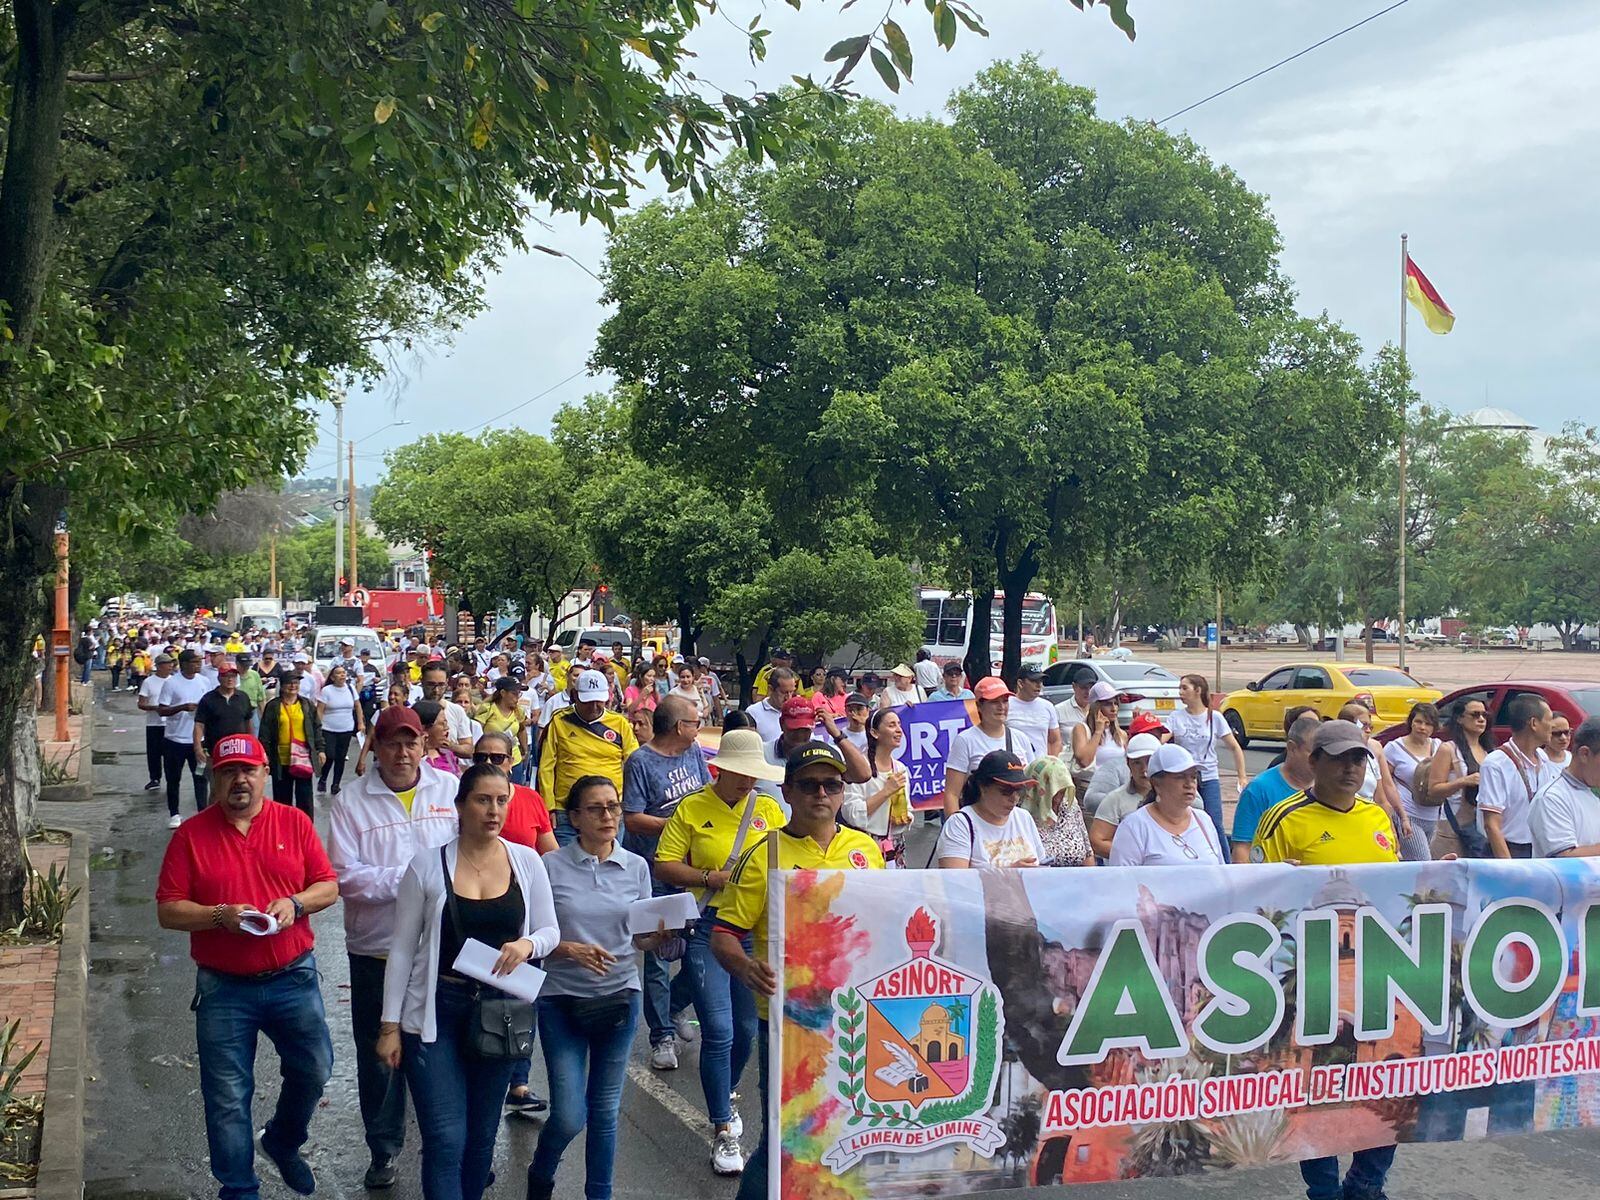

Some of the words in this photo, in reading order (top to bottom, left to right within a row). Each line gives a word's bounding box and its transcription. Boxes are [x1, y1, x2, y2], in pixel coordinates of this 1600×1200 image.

[668, 765, 689, 783] STAY
[927, 763, 938, 777] Y
[873, 961, 965, 998] ASINORT
[1060, 900, 1600, 1062] ASINO
[1046, 1080, 1196, 1127] ASOCIACIÓN
[1203, 1072, 1304, 1115] SINDICAL
[1311, 1068, 1343, 1101] DE
[1347, 1053, 1494, 1097] INSTITUTORES
[1499, 1040, 1600, 1080] NORTESAN
[851, 1131, 902, 1149] LUMEN
[905, 1133, 924, 1144] DE
[927, 1122, 981, 1141] LUMINE
